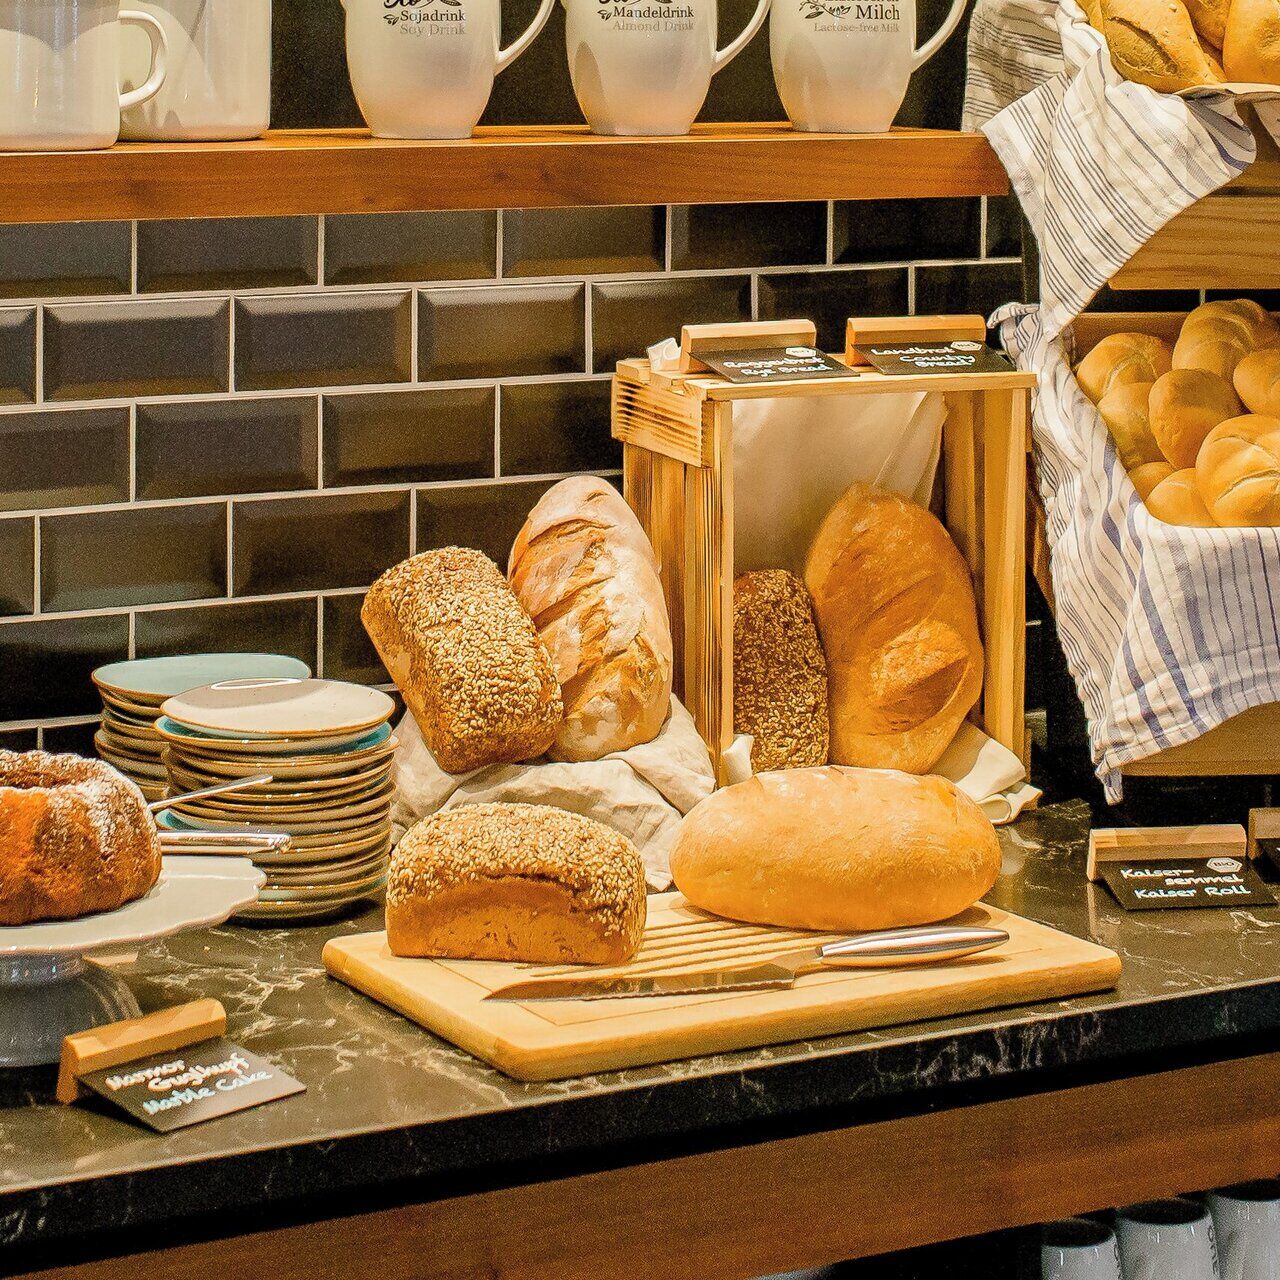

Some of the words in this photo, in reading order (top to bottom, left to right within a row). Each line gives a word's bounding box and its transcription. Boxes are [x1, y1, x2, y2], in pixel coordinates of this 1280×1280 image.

[399, 9, 467, 24] Sojadrink
[612, 5, 695, 19] Mandeldrink
[855, 3, 900, 20] Milch
[870, 346, 956, 356] Landbrot
[722, 356, 826, 369] Roggenbrot
[1212, 859, 1236, 869] BIO
[1120, 867, 1195, 880] Kaiser-
[1164, 873, 1244, 886] semmel
[1133, 887, 1198, 900] Kaiser
[1204, 884, 1252, 898] Roll
